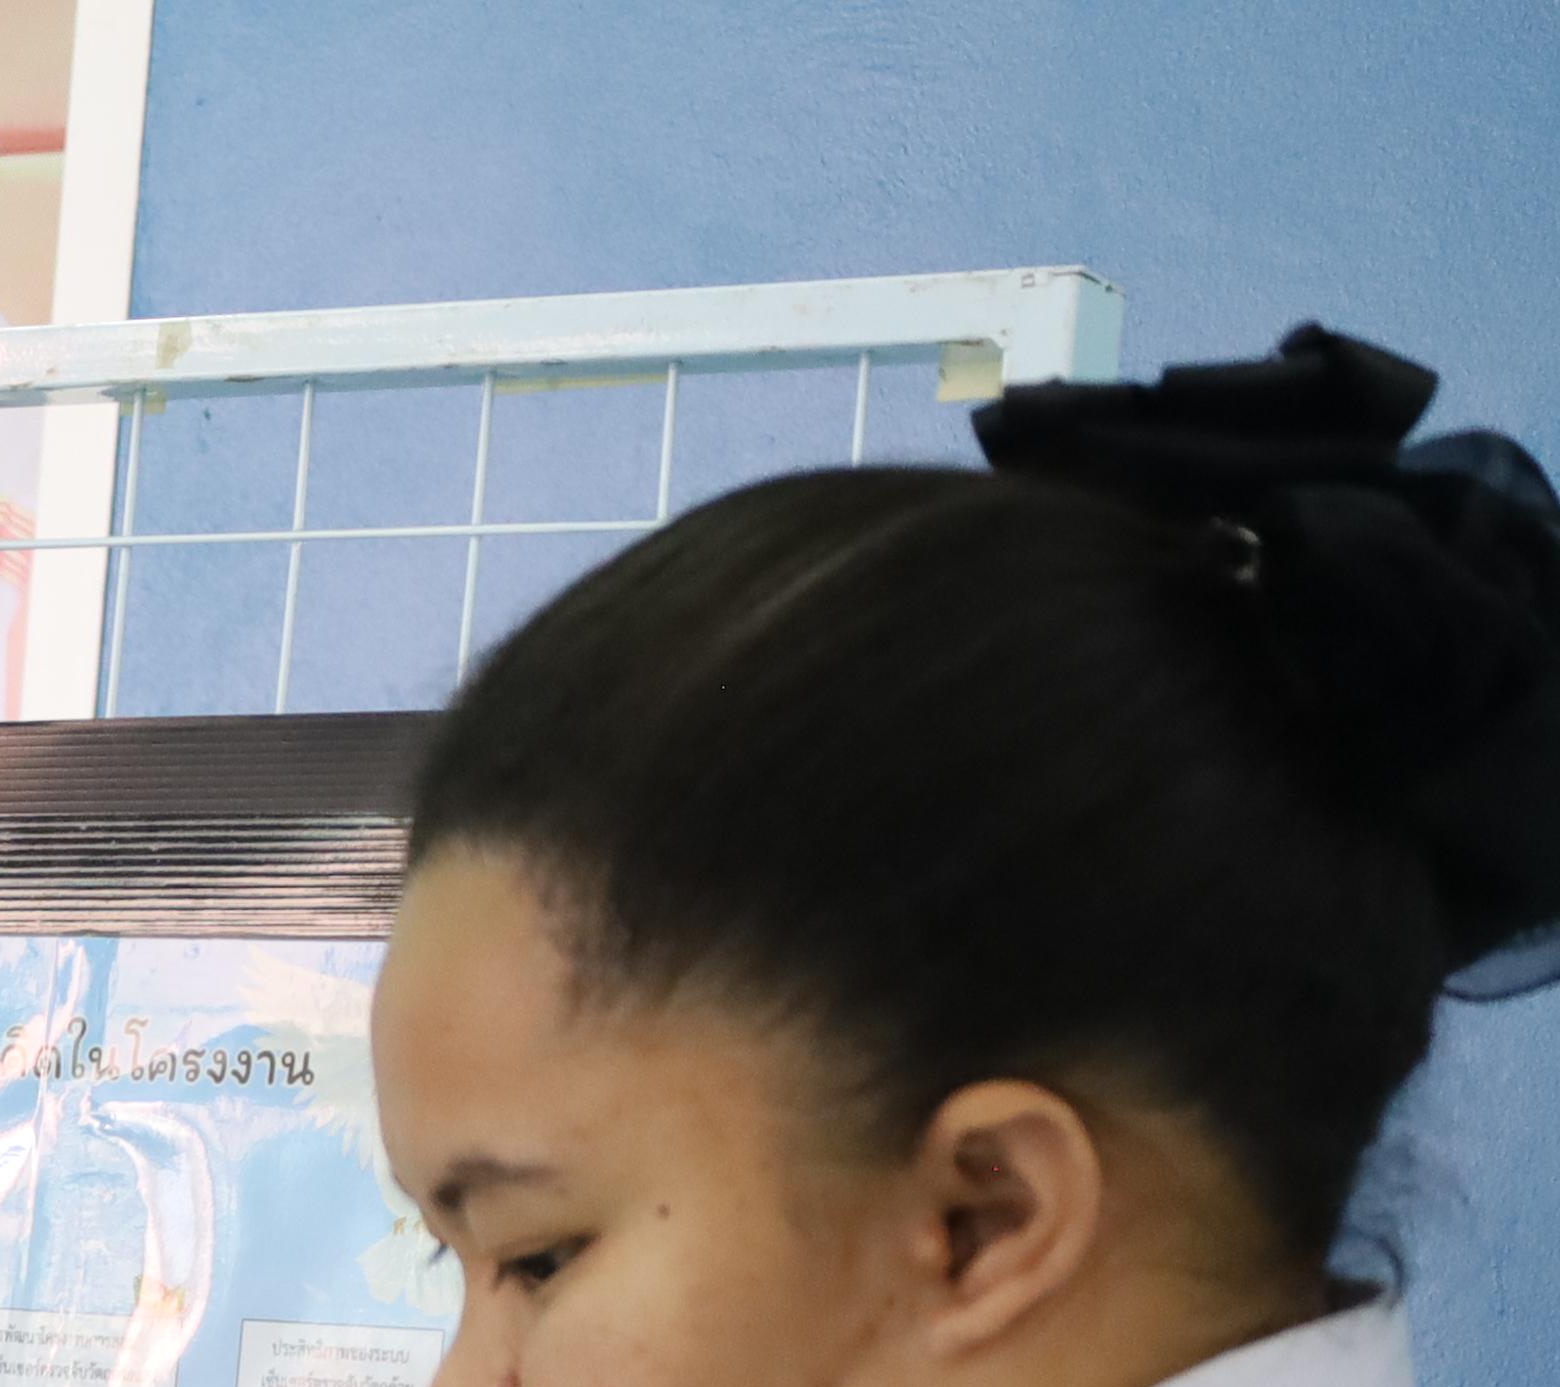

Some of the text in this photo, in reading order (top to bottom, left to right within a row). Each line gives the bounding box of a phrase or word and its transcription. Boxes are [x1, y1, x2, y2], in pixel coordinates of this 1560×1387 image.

[271, 1336, 409, 1365] ประสิทธิภาพของระบบ
